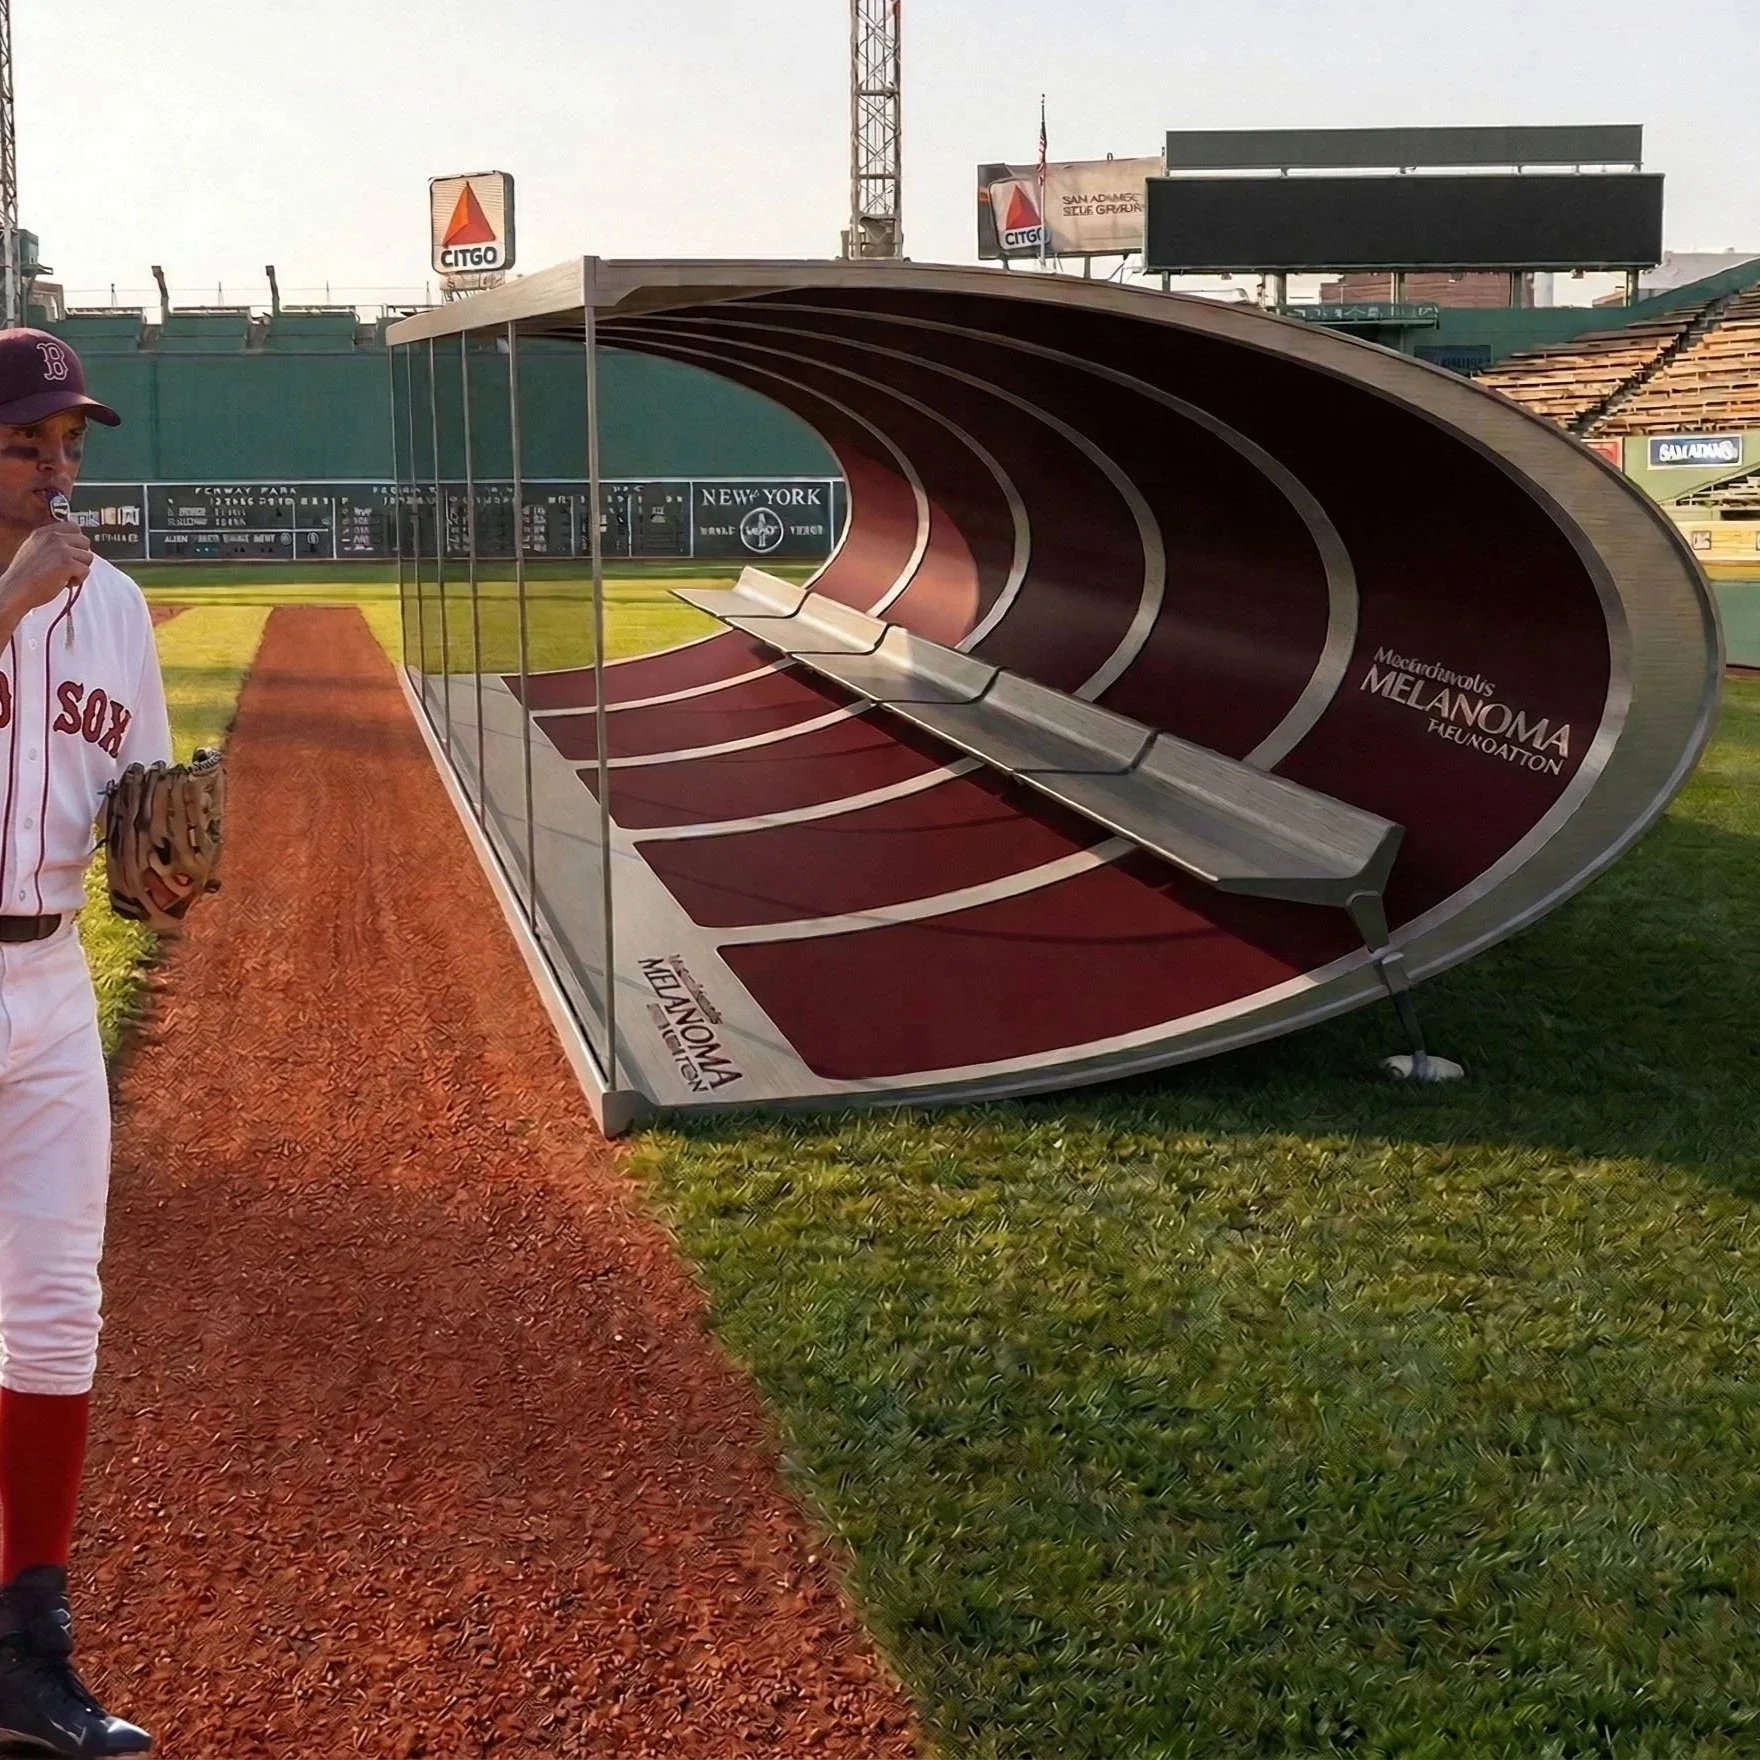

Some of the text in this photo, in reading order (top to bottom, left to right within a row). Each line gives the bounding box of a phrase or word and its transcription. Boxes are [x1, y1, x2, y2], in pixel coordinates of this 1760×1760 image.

[441, 246, 497, 267] CITGO
[37, 343, 69, 380] B
[701, 487, 822, 506] NEW YORK
[53, 681, 132, 758] SOX
[1359, 663, 1571, 759] MELANOMA
[637, 958, 743, 1089] MELANOMA
